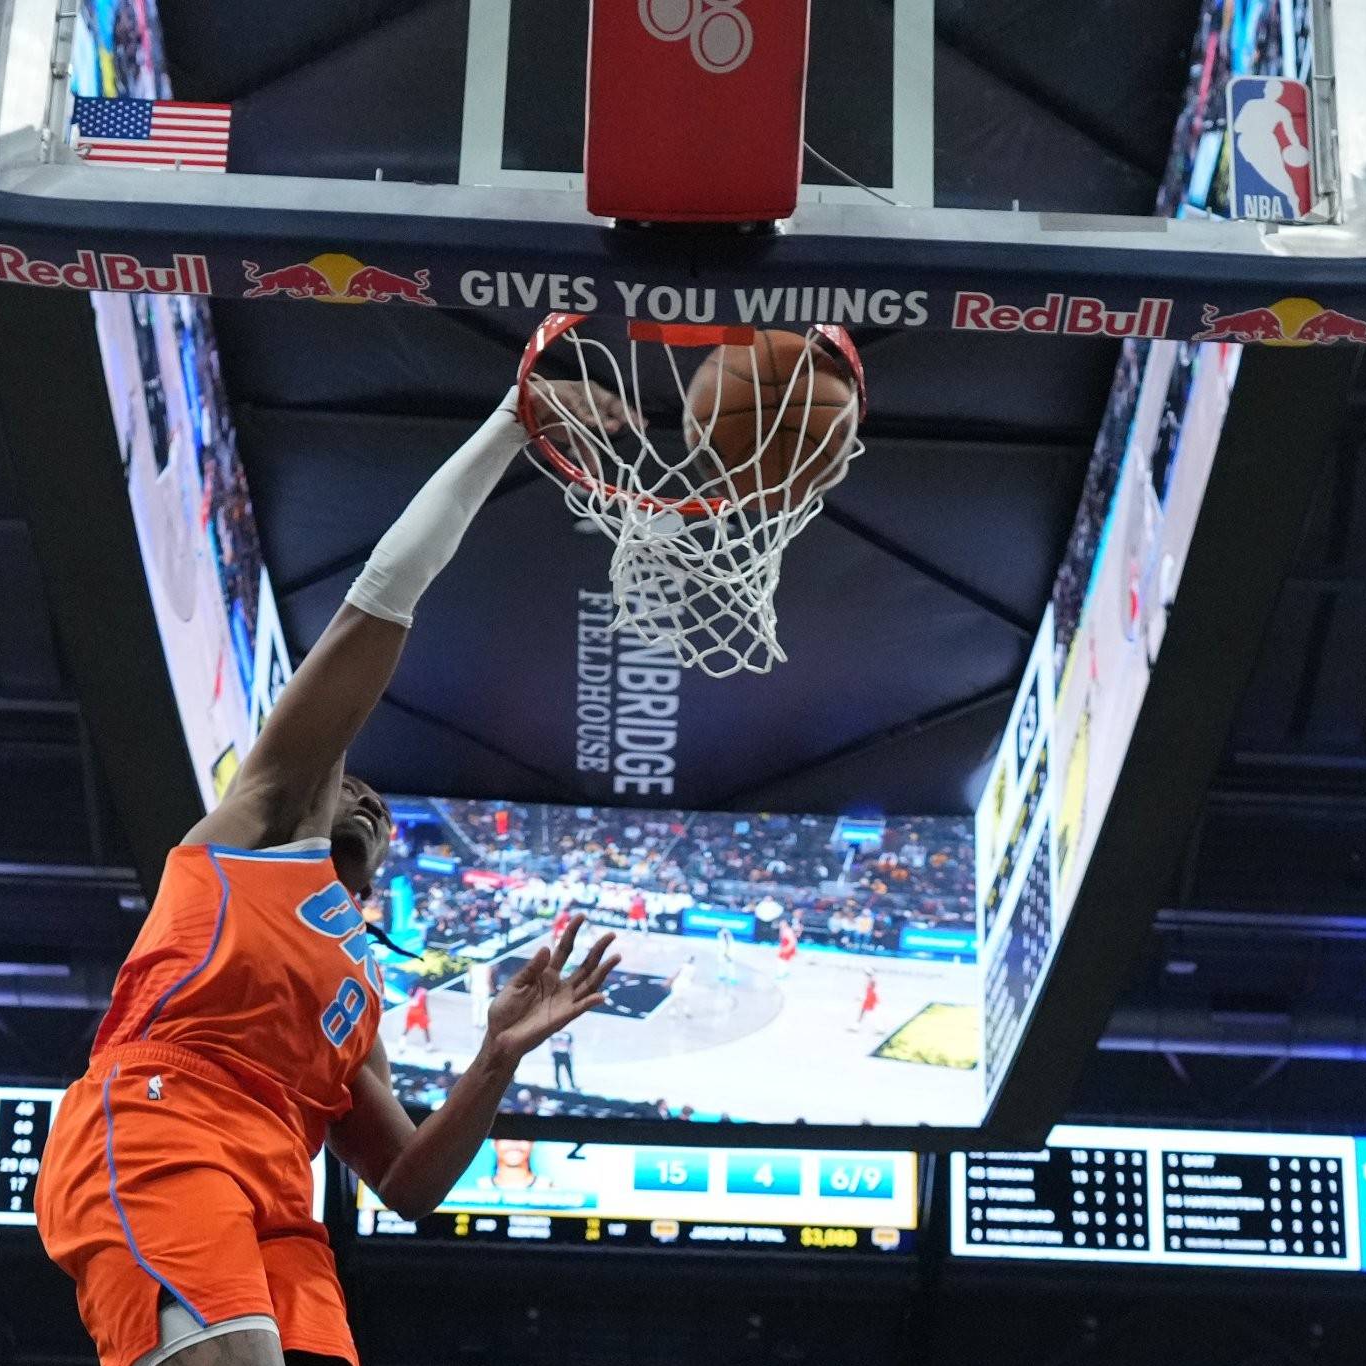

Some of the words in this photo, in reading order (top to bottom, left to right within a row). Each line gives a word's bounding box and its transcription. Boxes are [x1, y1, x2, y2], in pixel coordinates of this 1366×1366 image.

[1243, 194, 1284, 219] NBA
[459, 269, 598, 313] GIVES
[614, 280, 716, 323] YOU
[734, 286, 929, 326] WIIINGS
[576, 589, 614, 773] FIELDHOUSE
[320, 976, 367, 1048] 8
[657, 1158, 690, 1186] 15
[752, 1162, 775, 1188] 4
[830, 1165, 883, 1193] 6/9
